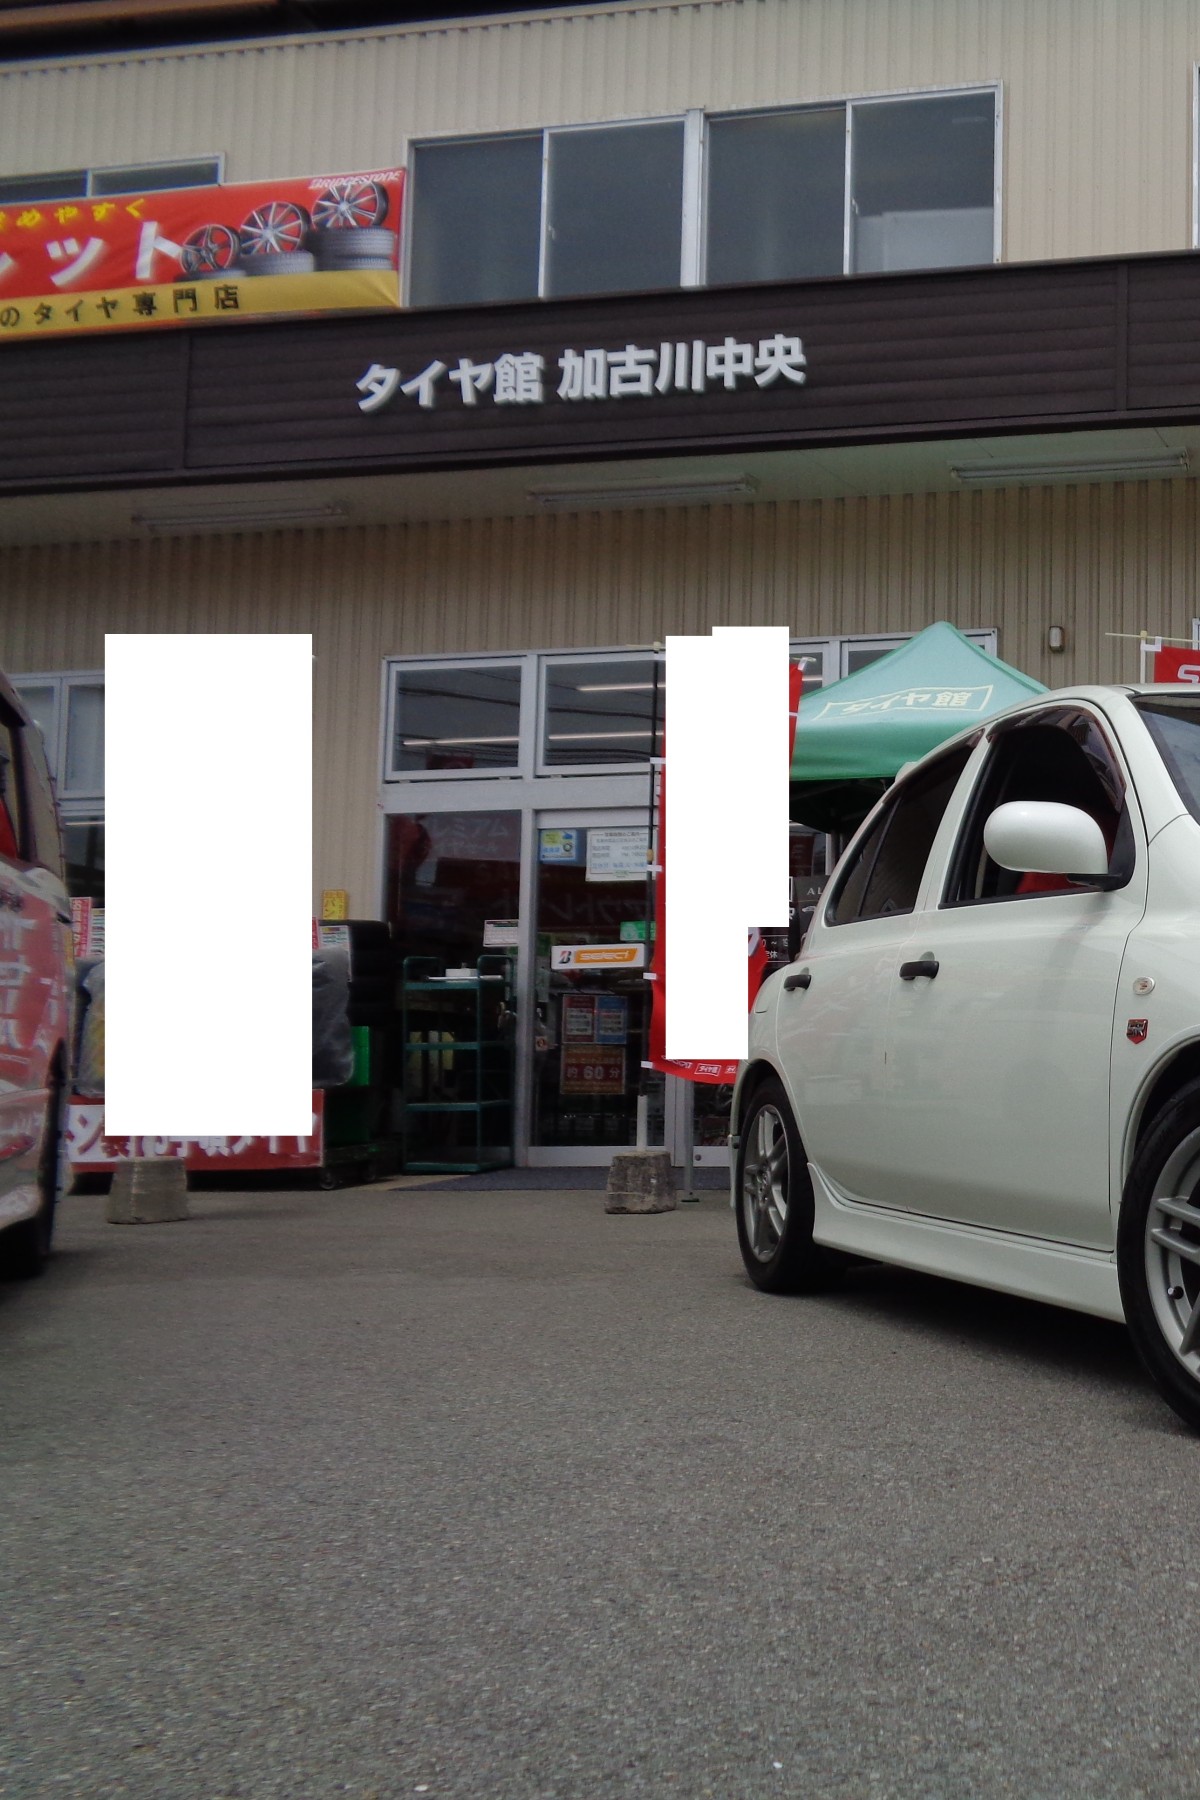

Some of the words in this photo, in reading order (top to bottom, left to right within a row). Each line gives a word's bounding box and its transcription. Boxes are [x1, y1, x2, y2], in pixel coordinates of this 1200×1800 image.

[308, 171, 402, 190] BRIDGESTONE
[0, 198, 145, 229] めやすく
[0, 220, 183, 287] ット
[0, 284, 240, 327] のタイヤ専門店
[355, 351, 545, 414] タイヤ館
[557, 332, 807, 400] 加古川中央
[841, 691, 973, 715] タイヤ館
